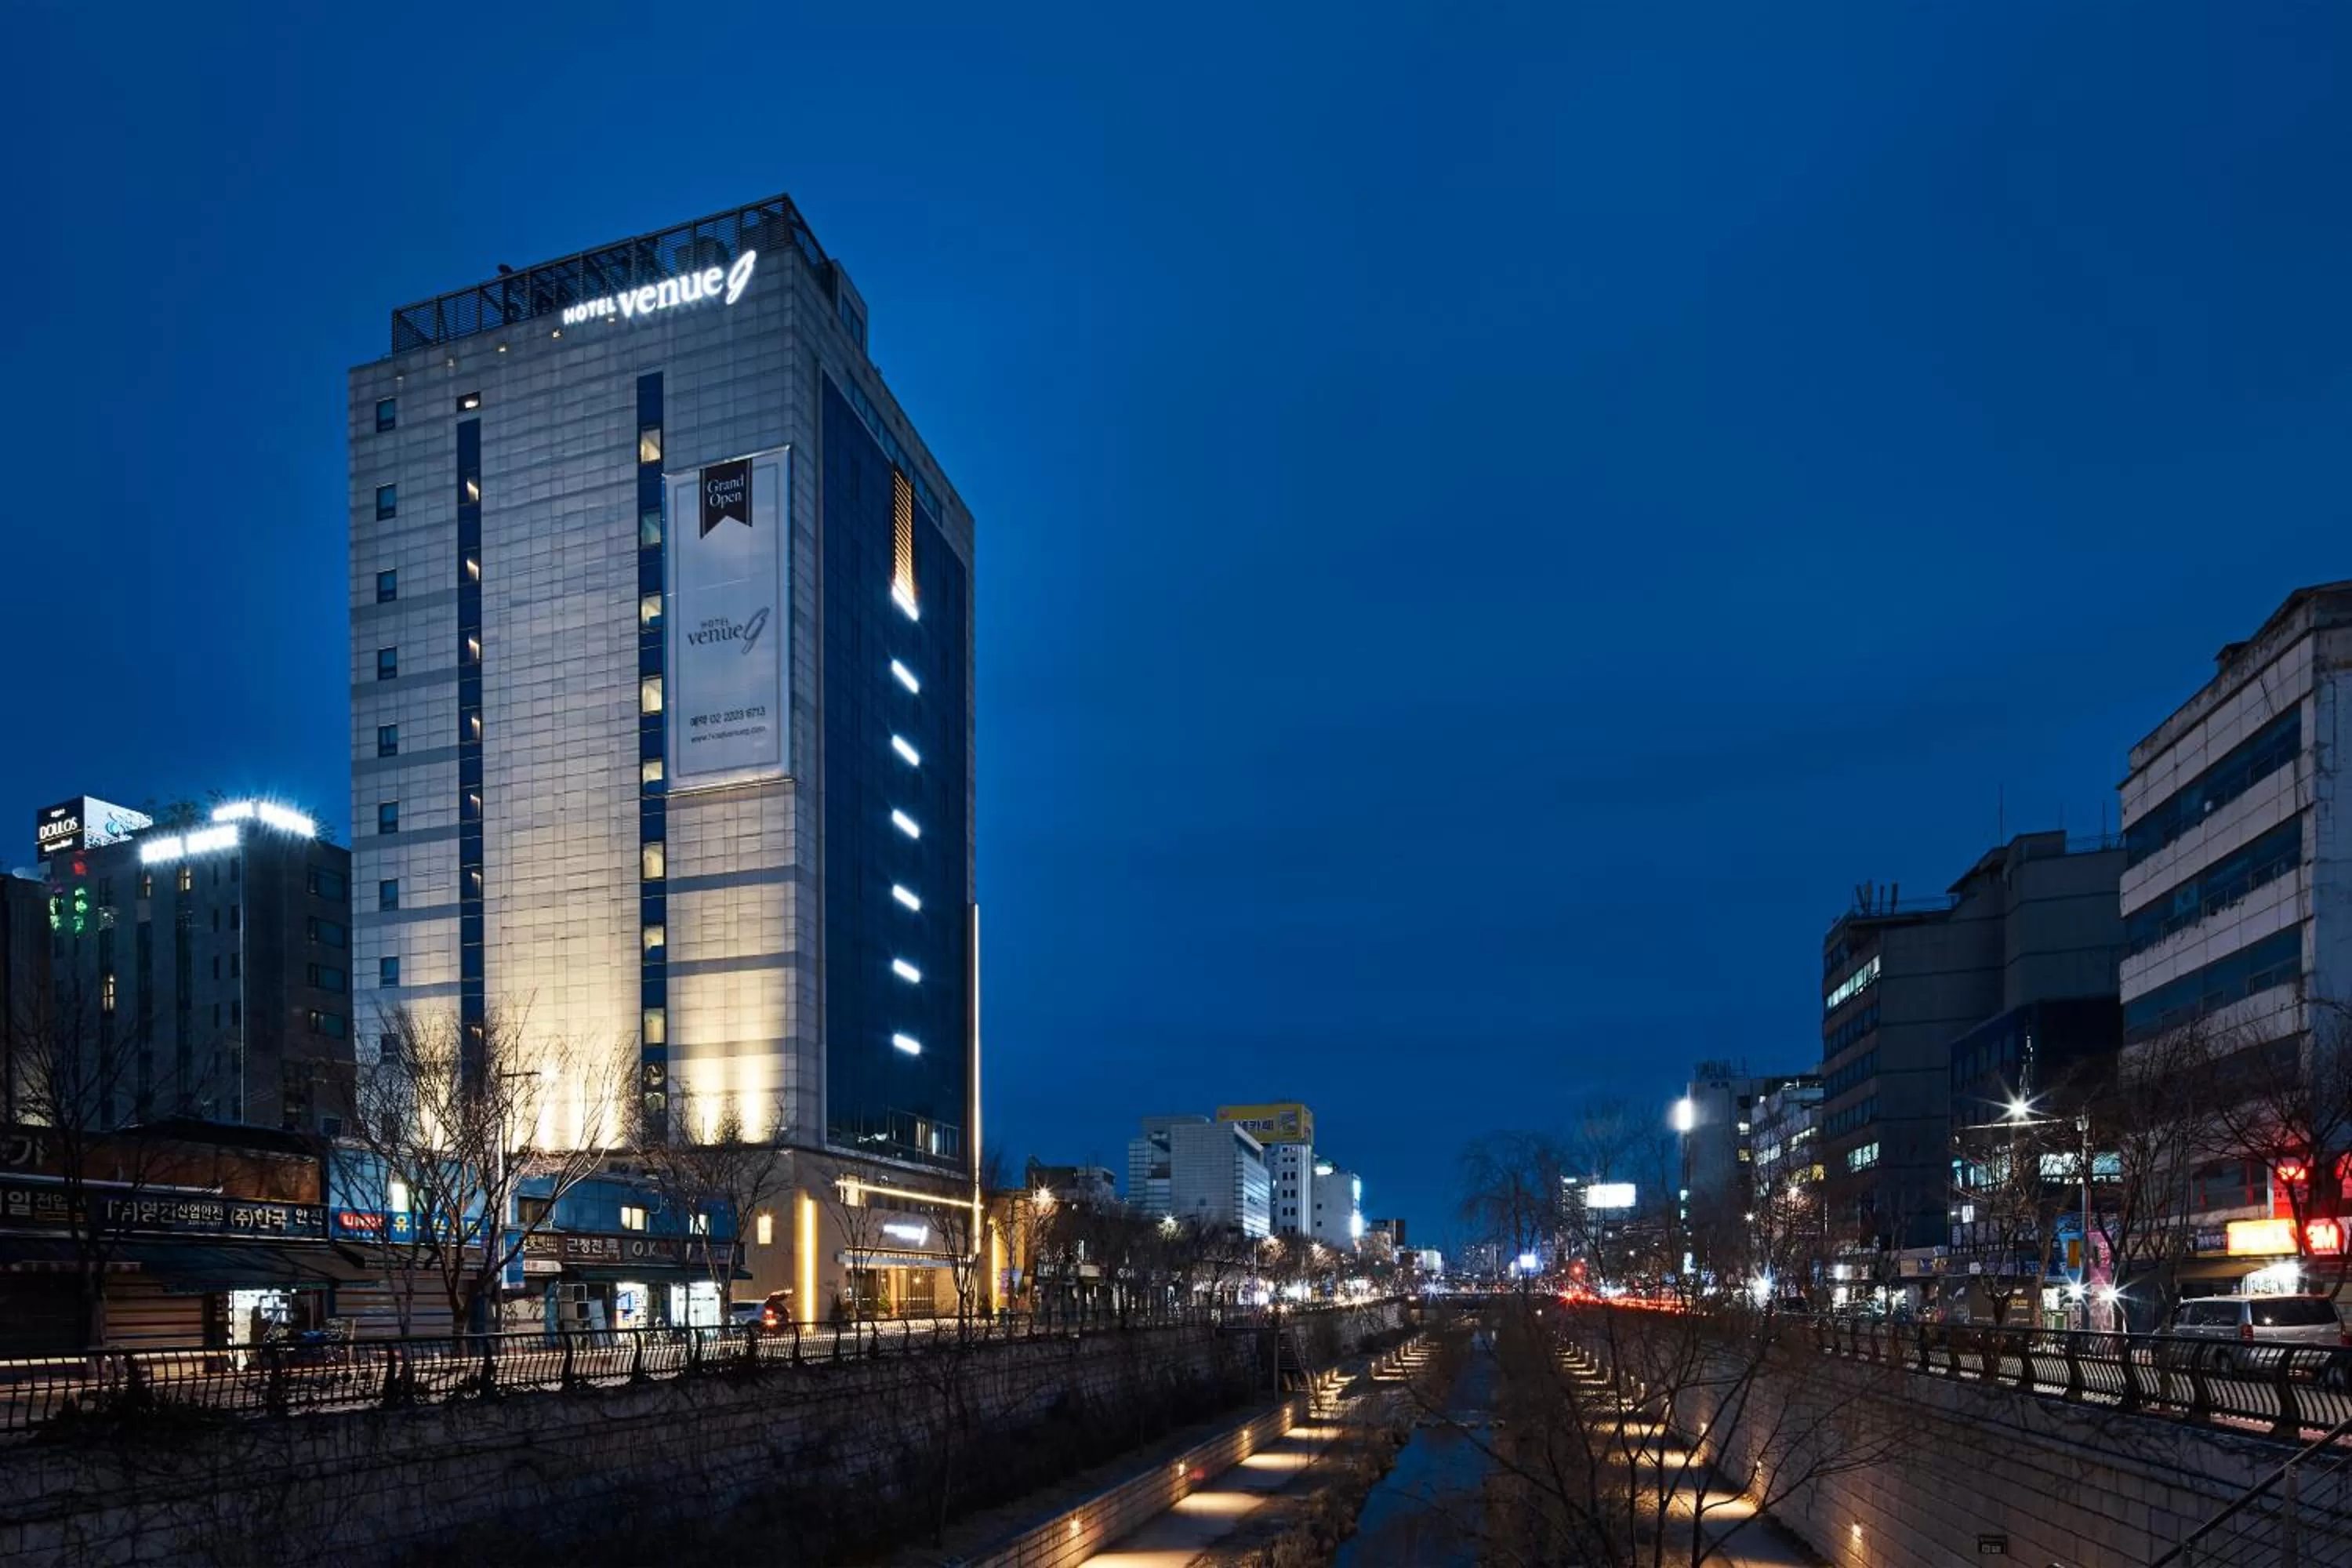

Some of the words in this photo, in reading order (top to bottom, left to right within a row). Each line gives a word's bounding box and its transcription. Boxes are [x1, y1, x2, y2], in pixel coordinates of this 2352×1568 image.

[563, 297, 615, 325] HOTEL
[707, 474, 744, 493] Grand
[710, 492, 742, 509] Open
